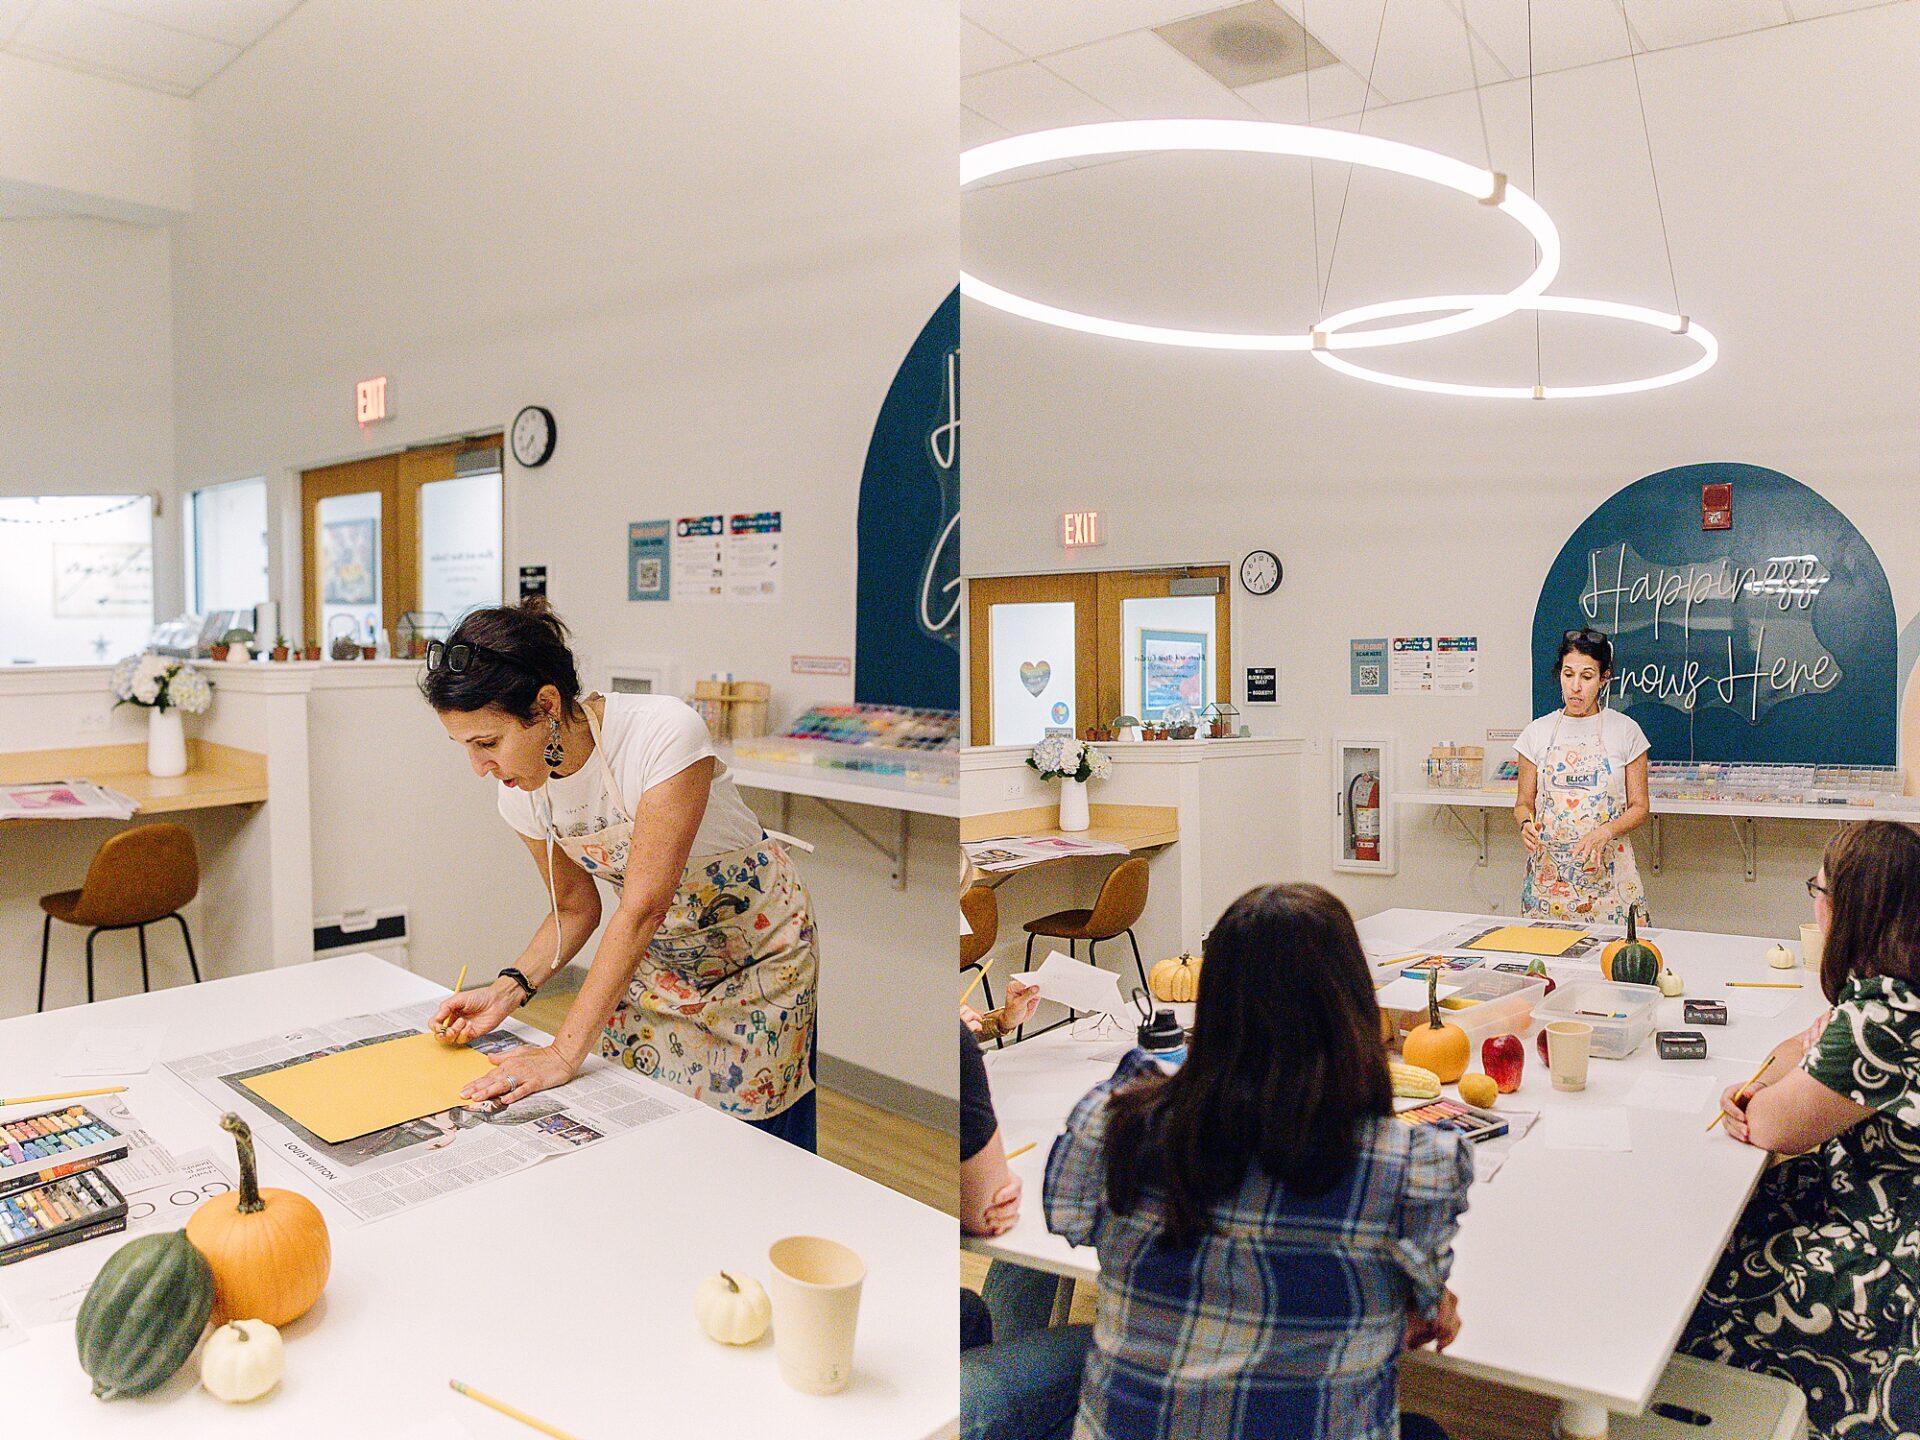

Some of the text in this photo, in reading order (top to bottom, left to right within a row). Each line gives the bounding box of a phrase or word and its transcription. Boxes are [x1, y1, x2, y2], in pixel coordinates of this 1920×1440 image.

[1065, 512, 1097, 545] EXIT
[1583, 542, 1822, 640] Happiness
[1717, 626, 1838, 722] Here
[1566, 775, 1590, 783] BLICK
[284, 1142, 338, 1180] LOUIS VUITTON
